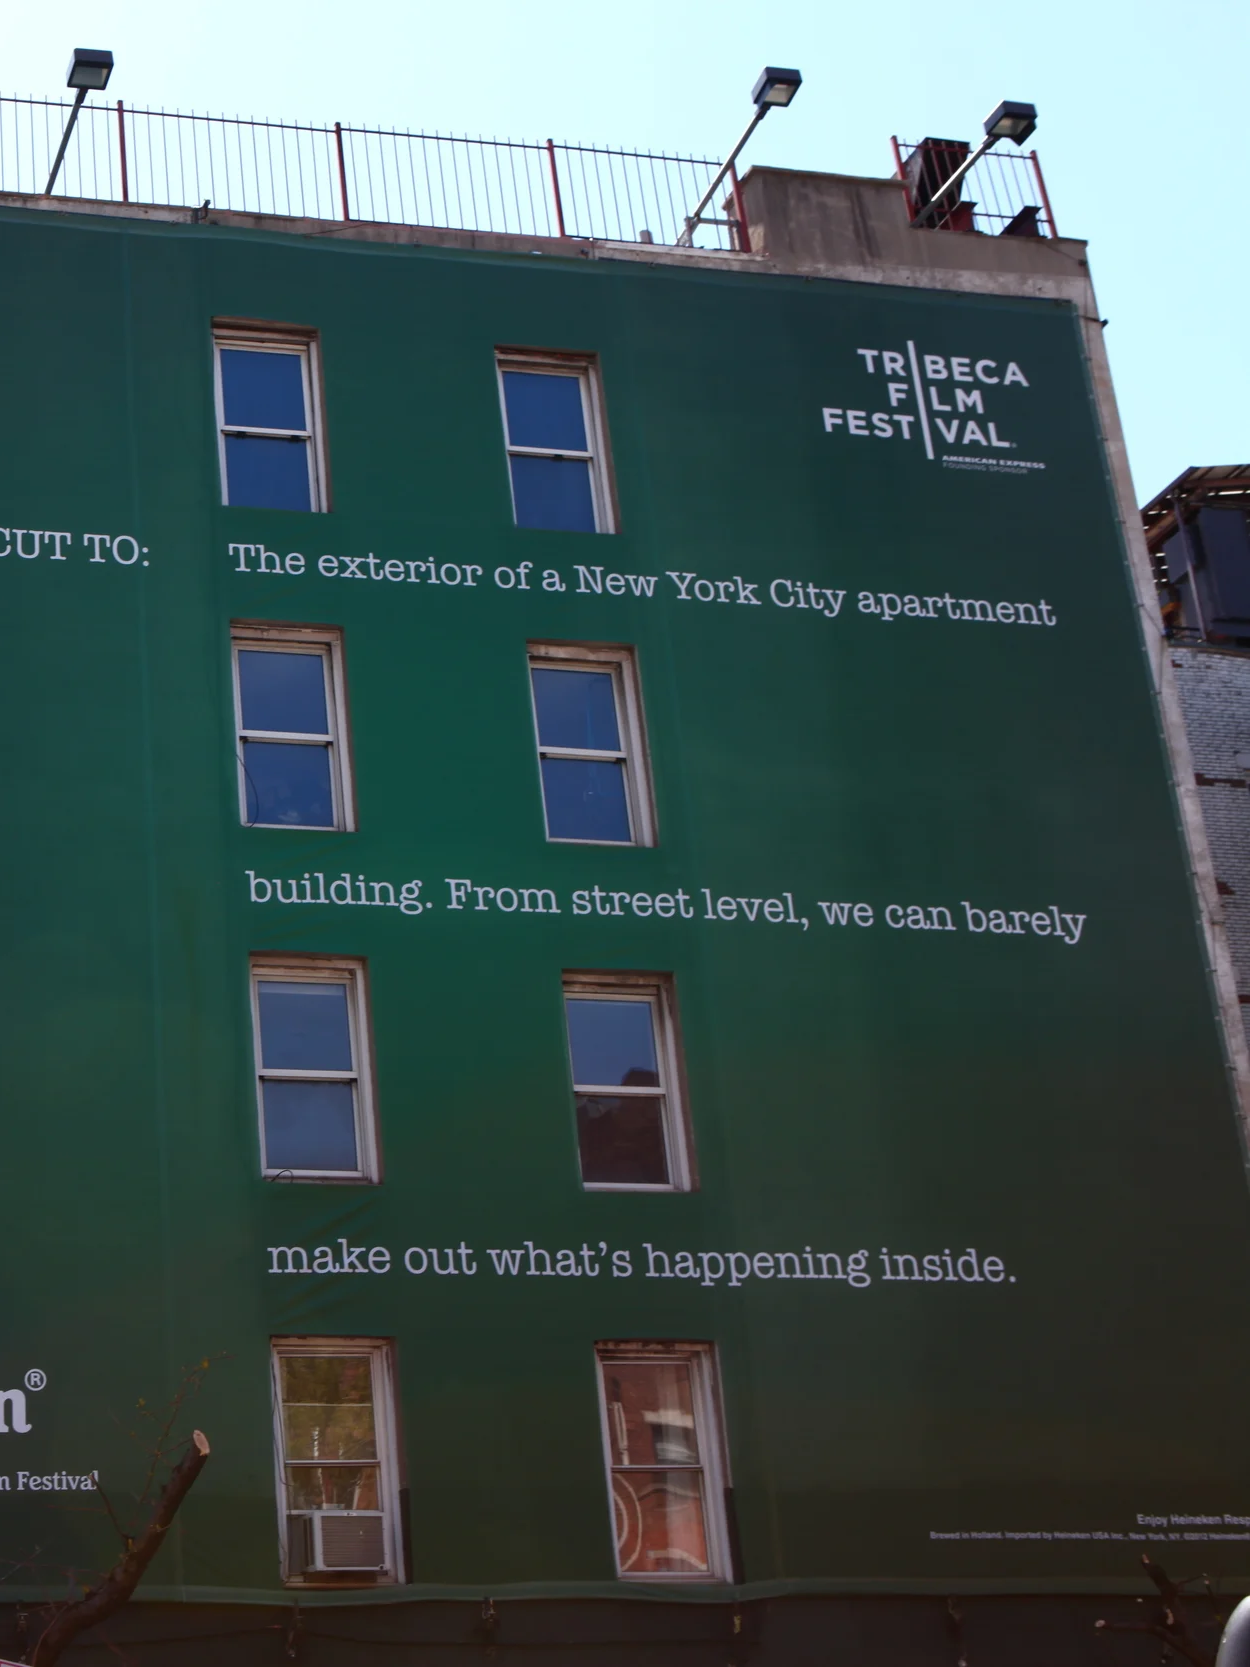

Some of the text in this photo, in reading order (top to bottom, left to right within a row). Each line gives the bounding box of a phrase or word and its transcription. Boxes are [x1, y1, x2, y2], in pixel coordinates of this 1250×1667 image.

[941, 454, 1046, 470] AMERICAN EXPRESS
[83, 533, 150, 567] TO:
[228, 543, 1057, 626] The exterior of a New York City apartment
[244, 870, 1087, 945] building. From street level, we can barely
[267, 1238, 1016, 1288] make out what's happening inside.
[16, 1470, 99, 1491] Festival
[1136, 1513, 1168, 1527] Enjoy
[1170, 1514, 1222, 1525] Heineken
[930, 1531, 960, 1539] Brewed
[961, 1531, 969, 1539] in
[1005, 1531, 1041, 1540] Imported
[1042, 1531, 1052, 1540] by
[1053, 1531, 1091, 1539] Heineken
[1128, 1532, 1146, 1540] New
